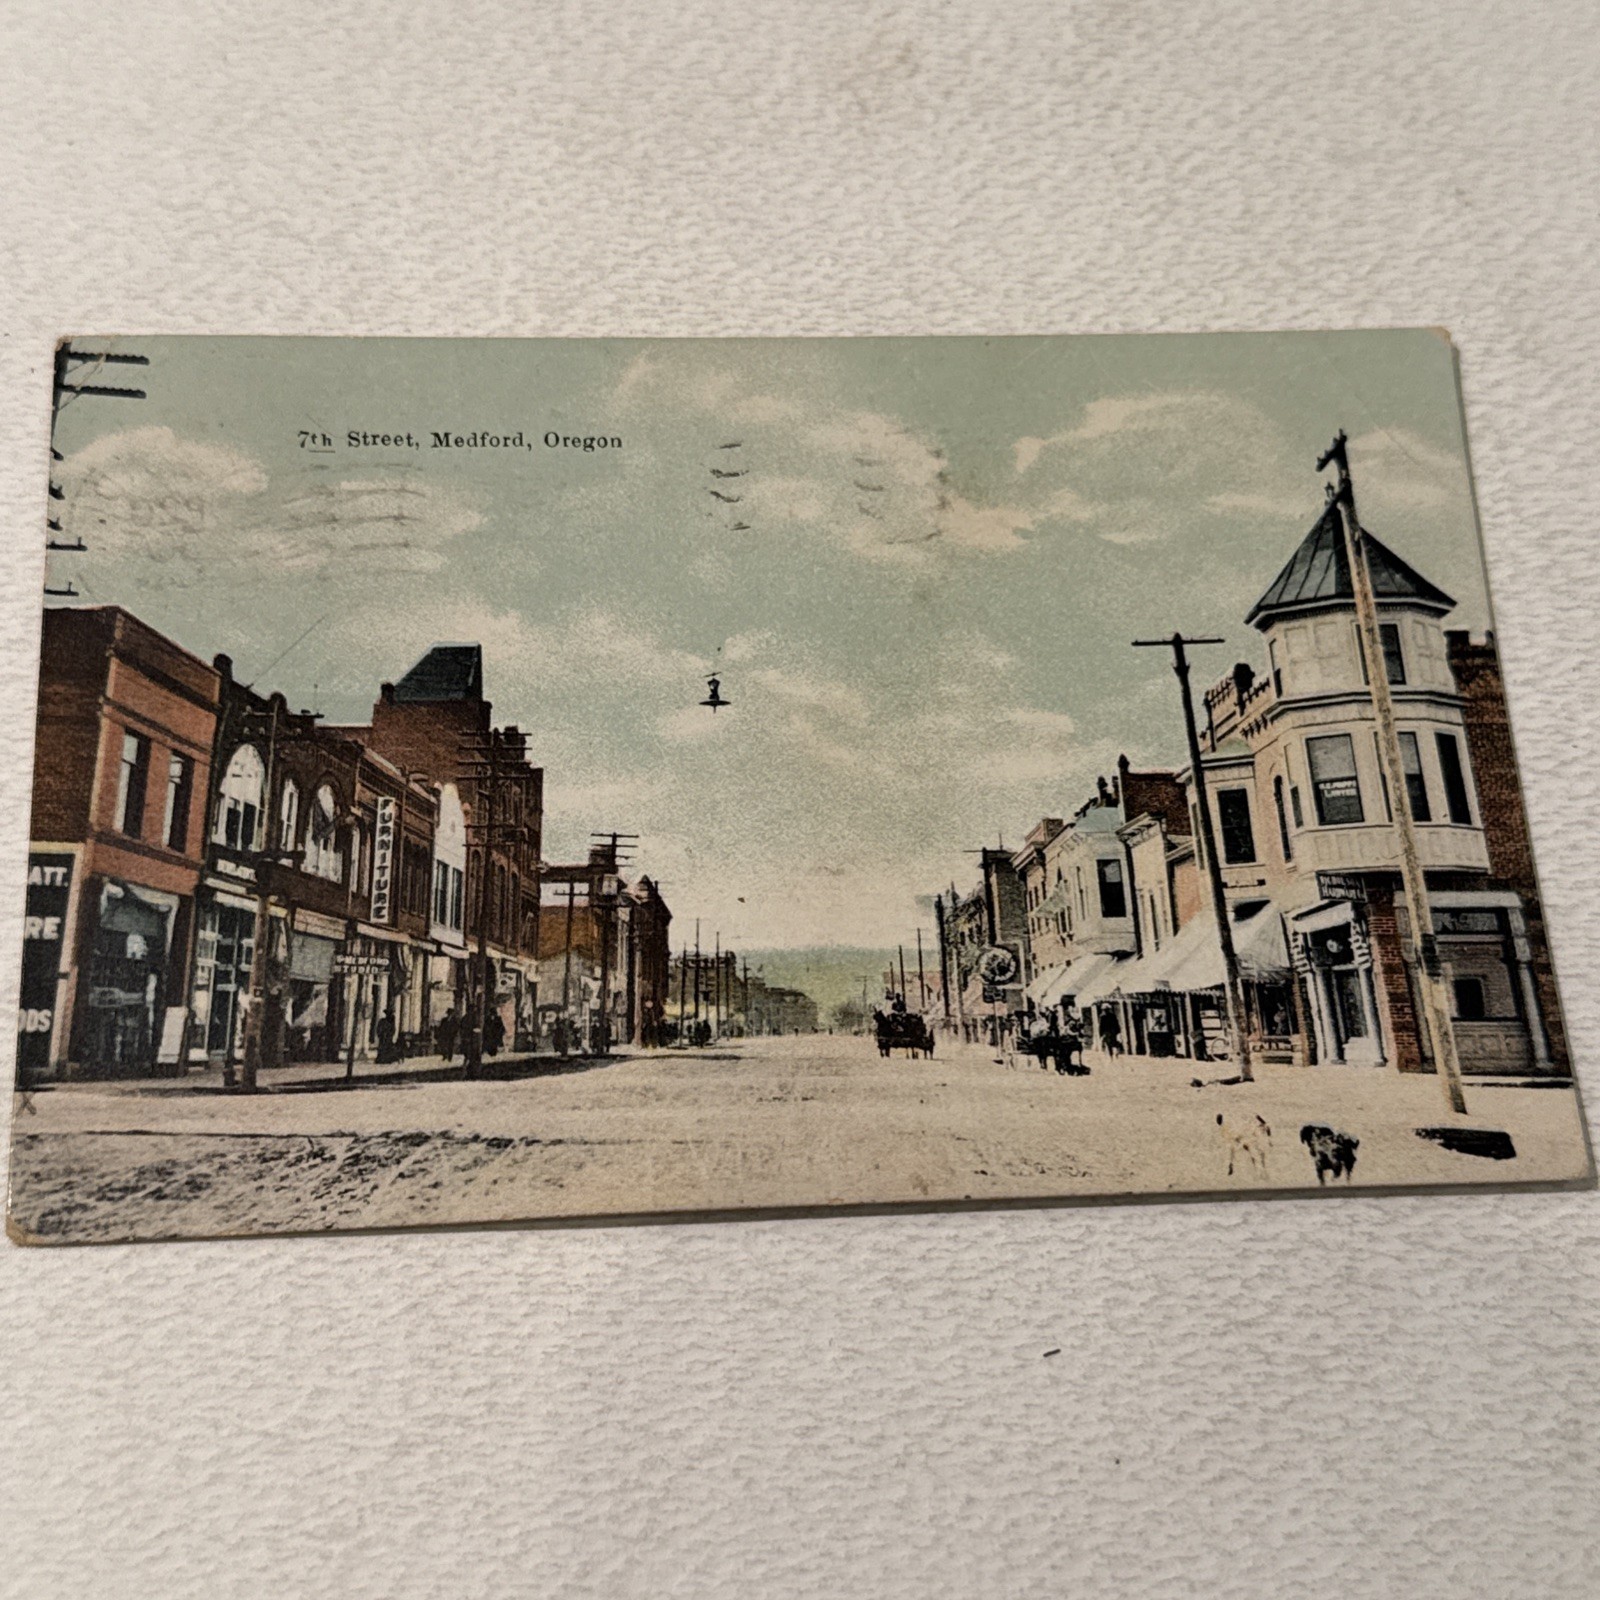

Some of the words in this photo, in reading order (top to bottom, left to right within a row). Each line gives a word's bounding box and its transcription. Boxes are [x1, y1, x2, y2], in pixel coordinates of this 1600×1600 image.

[297, 429, 333, 453] 7th
[347, 430, 420, 450] Street,
[431, 431, 533, 452] Medford,
[544, 431, 623, 452] Oregon
[372, 798, 394, 920] FURNITURE
